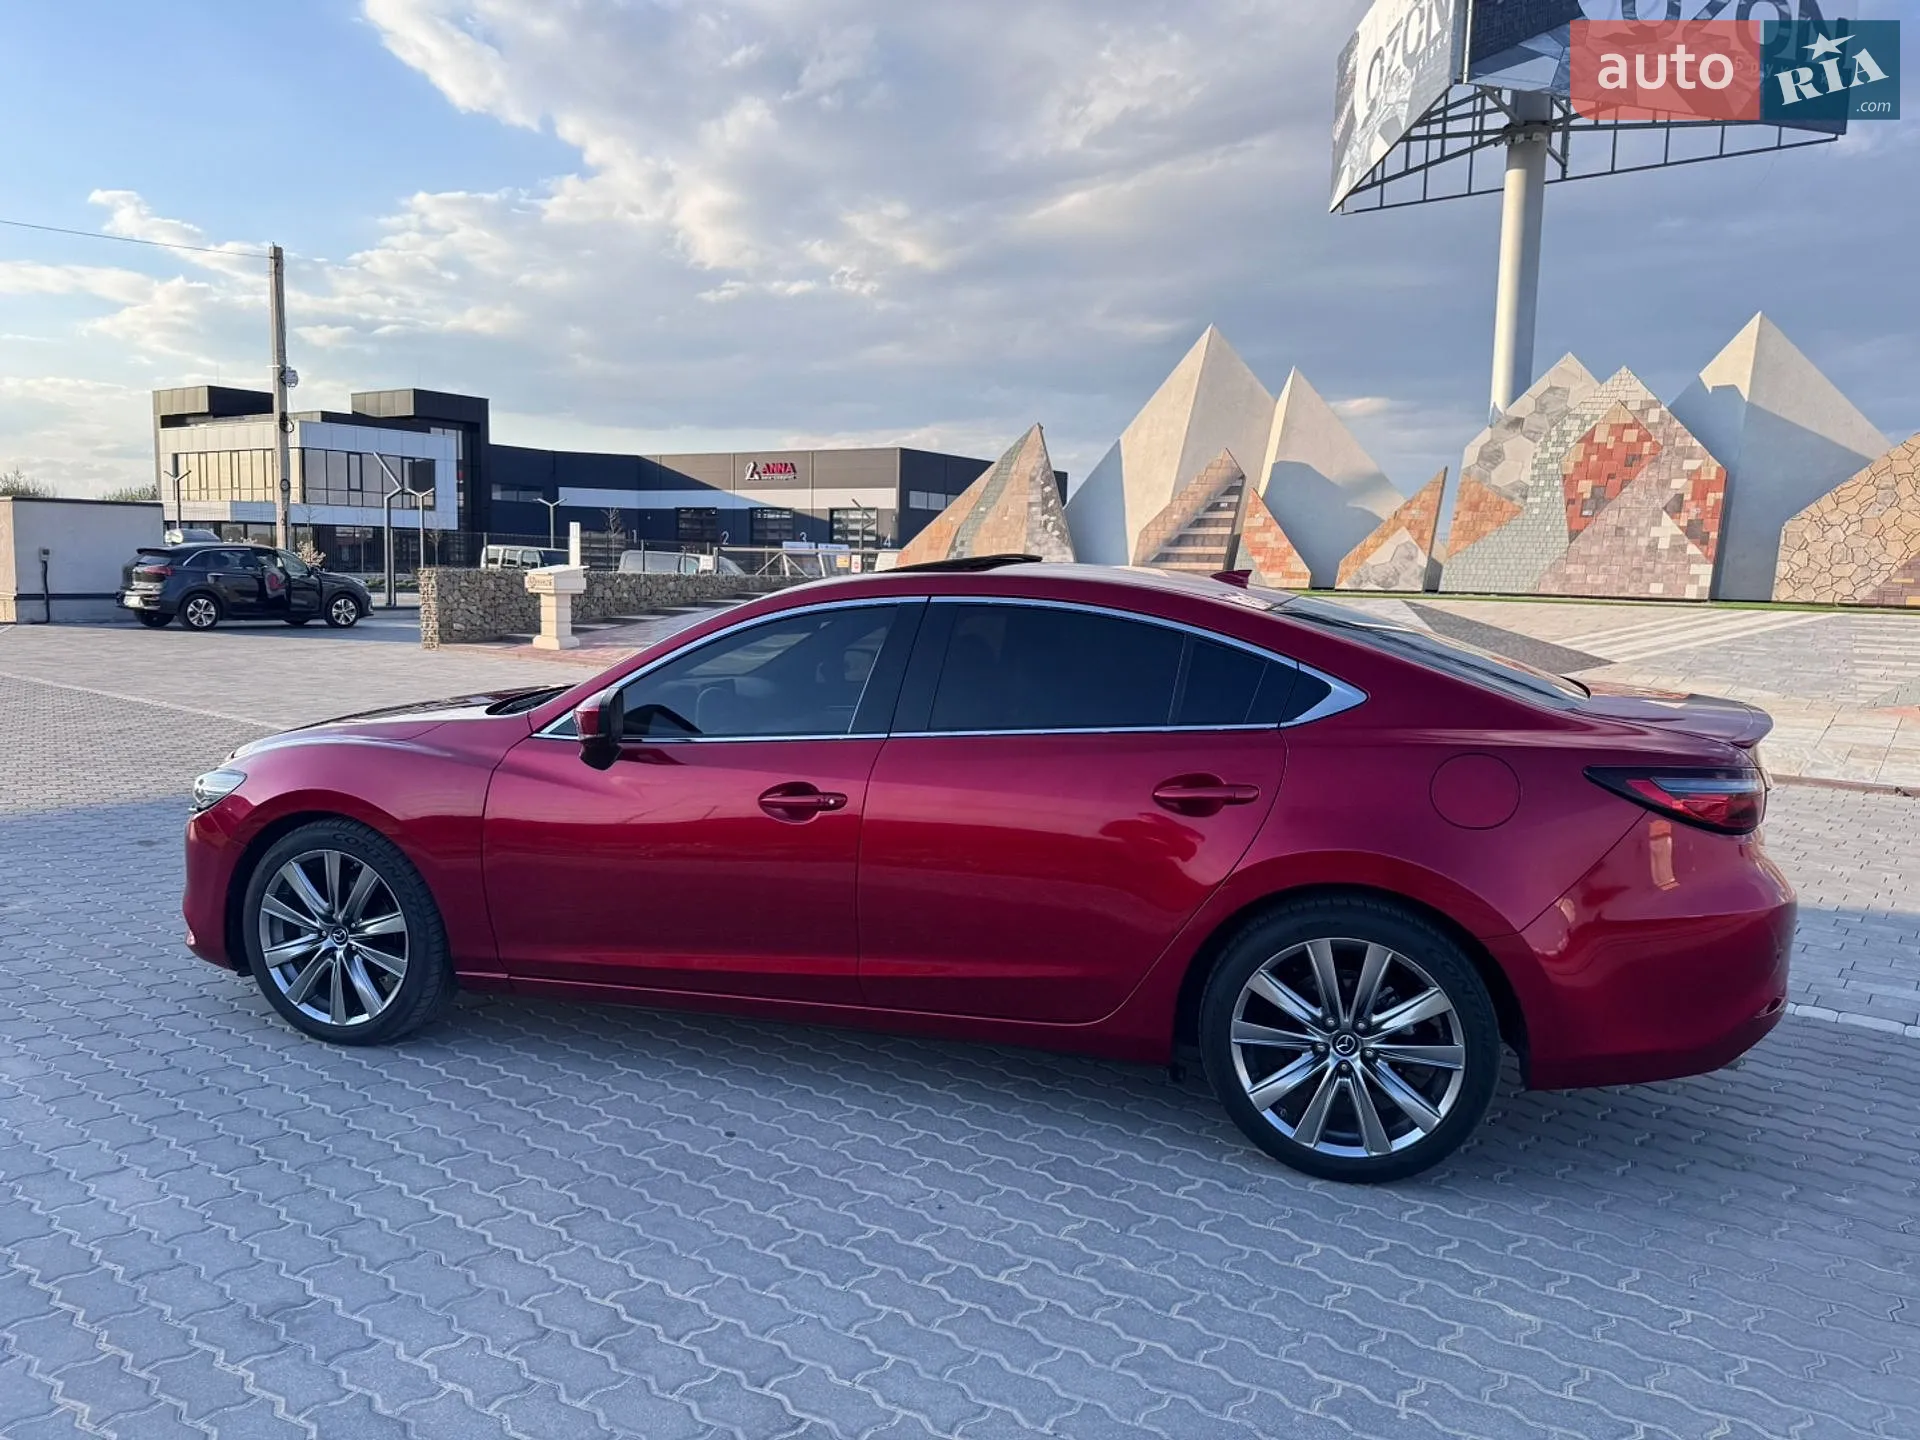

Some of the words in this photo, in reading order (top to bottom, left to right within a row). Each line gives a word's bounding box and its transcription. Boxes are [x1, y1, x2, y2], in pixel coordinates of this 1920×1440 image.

[762, 462, 797, 475] ANNA
[721, 531, 729, 545] 2
[883, 533, 891, 547] 4
